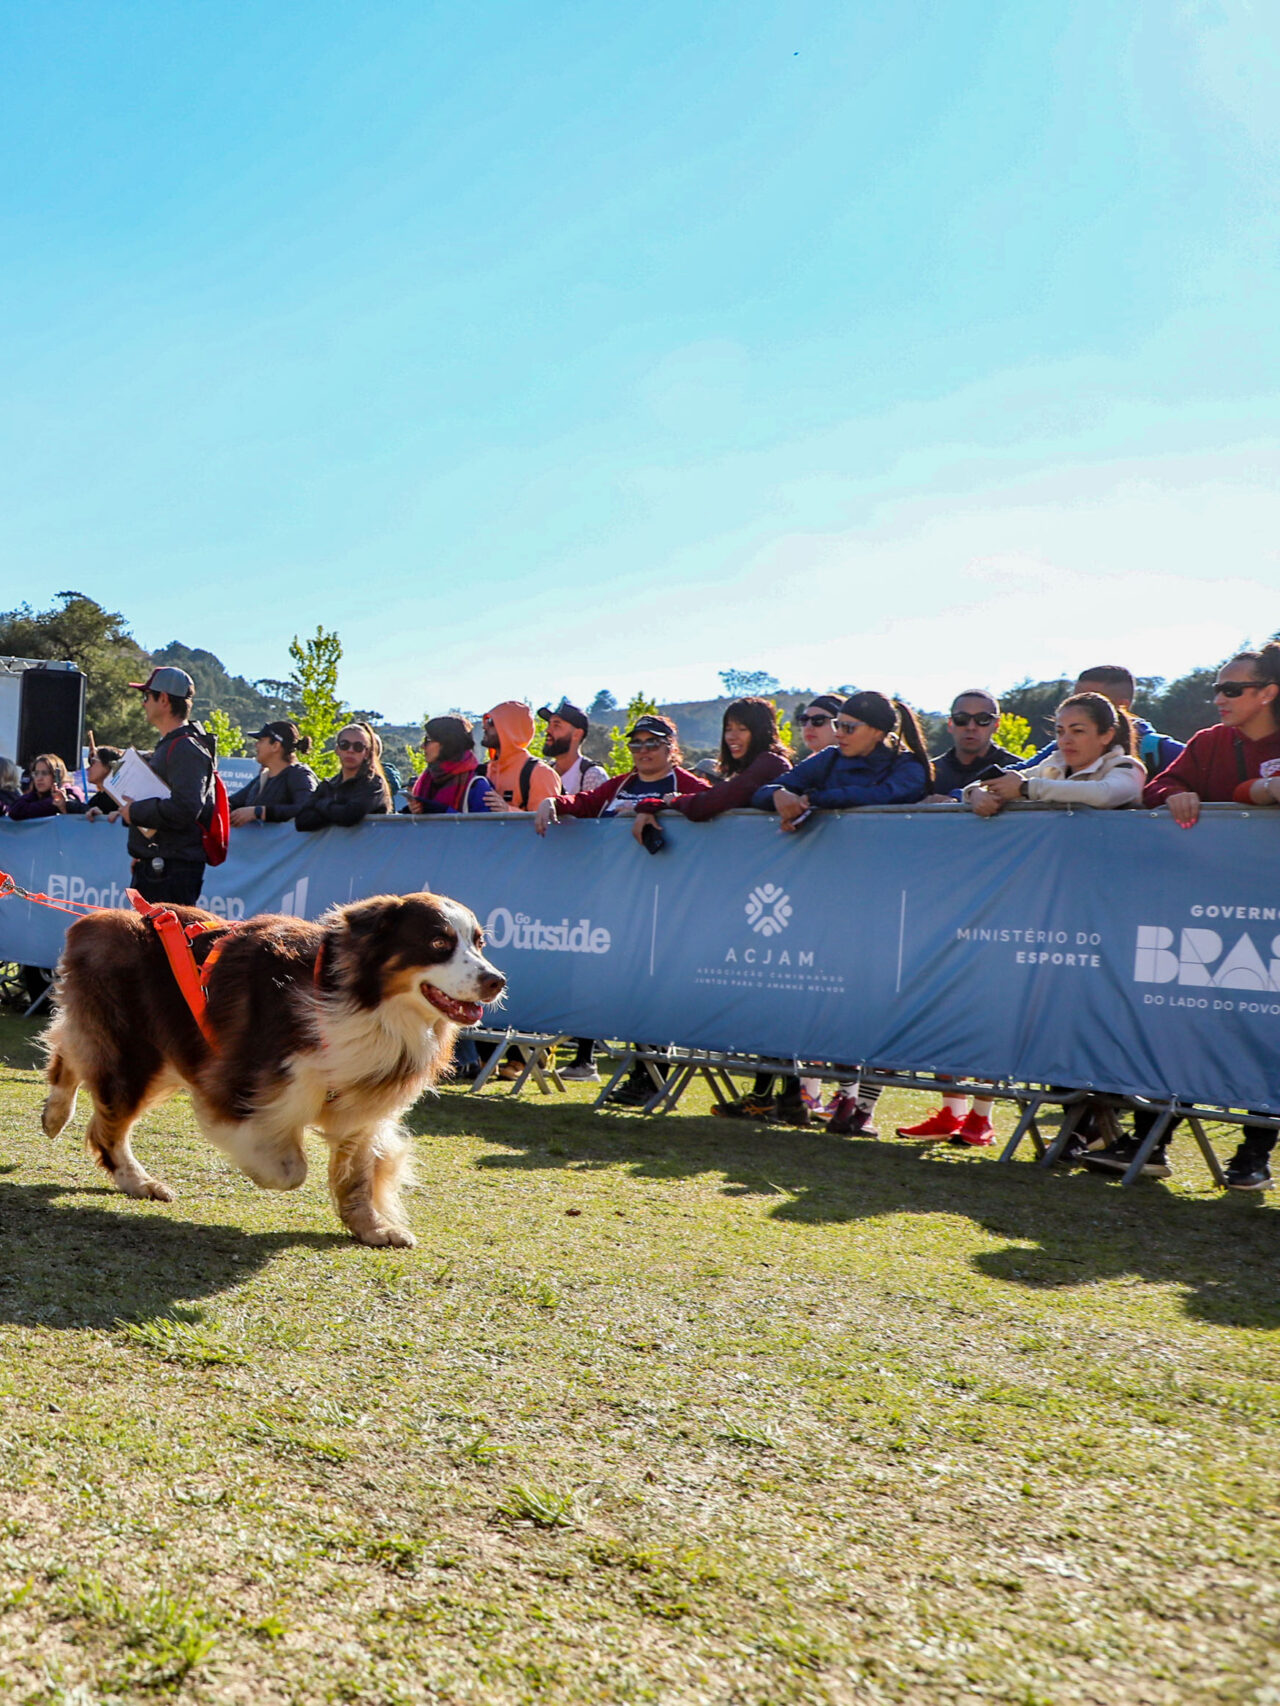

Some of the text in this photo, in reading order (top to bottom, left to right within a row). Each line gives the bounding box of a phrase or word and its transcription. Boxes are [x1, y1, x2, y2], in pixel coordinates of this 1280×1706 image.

[195, 894, 245, 921] eep
[515, 912, 531, 924] Go
[486, 907, 611, 954] Outside
[956, 928, 1101, 945] MINISTÉRIO DO
[724, 948, 814, 967] ACJAM
[1016, 951, 1101, 967] ESPORTE
[1144, 994, 1280, 1015] DO LADO DO POVO
